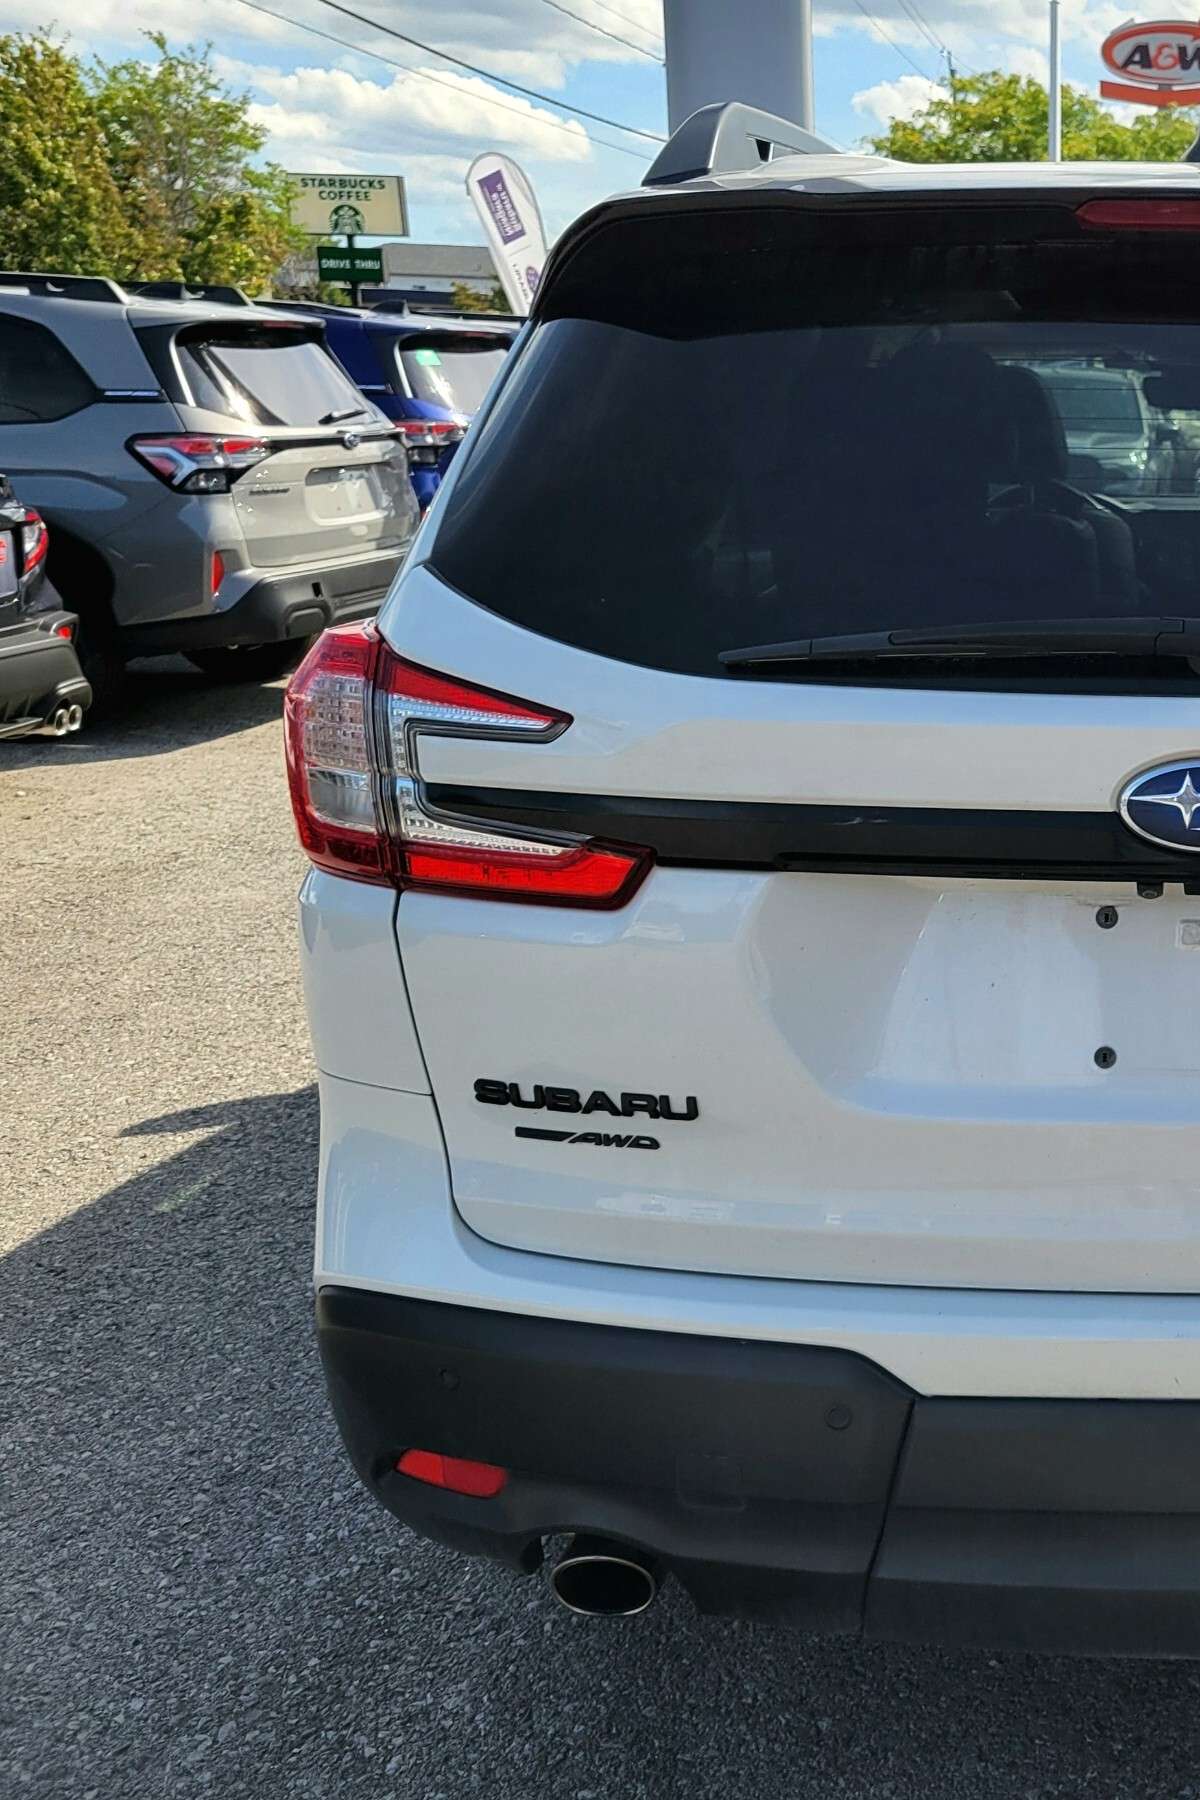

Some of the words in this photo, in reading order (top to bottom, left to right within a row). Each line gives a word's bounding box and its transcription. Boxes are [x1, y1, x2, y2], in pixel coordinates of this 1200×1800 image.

[300, 177, 386, 190] STARBUCKS
[318, 190, 372, 202] COFFEE
[321, 258, 351, 269] DRIVE
[354, 259, 380, 270] THRU
[473, 1078, 699, 1121] SUBARU
[568, 1131, 661, 1150] AWD
